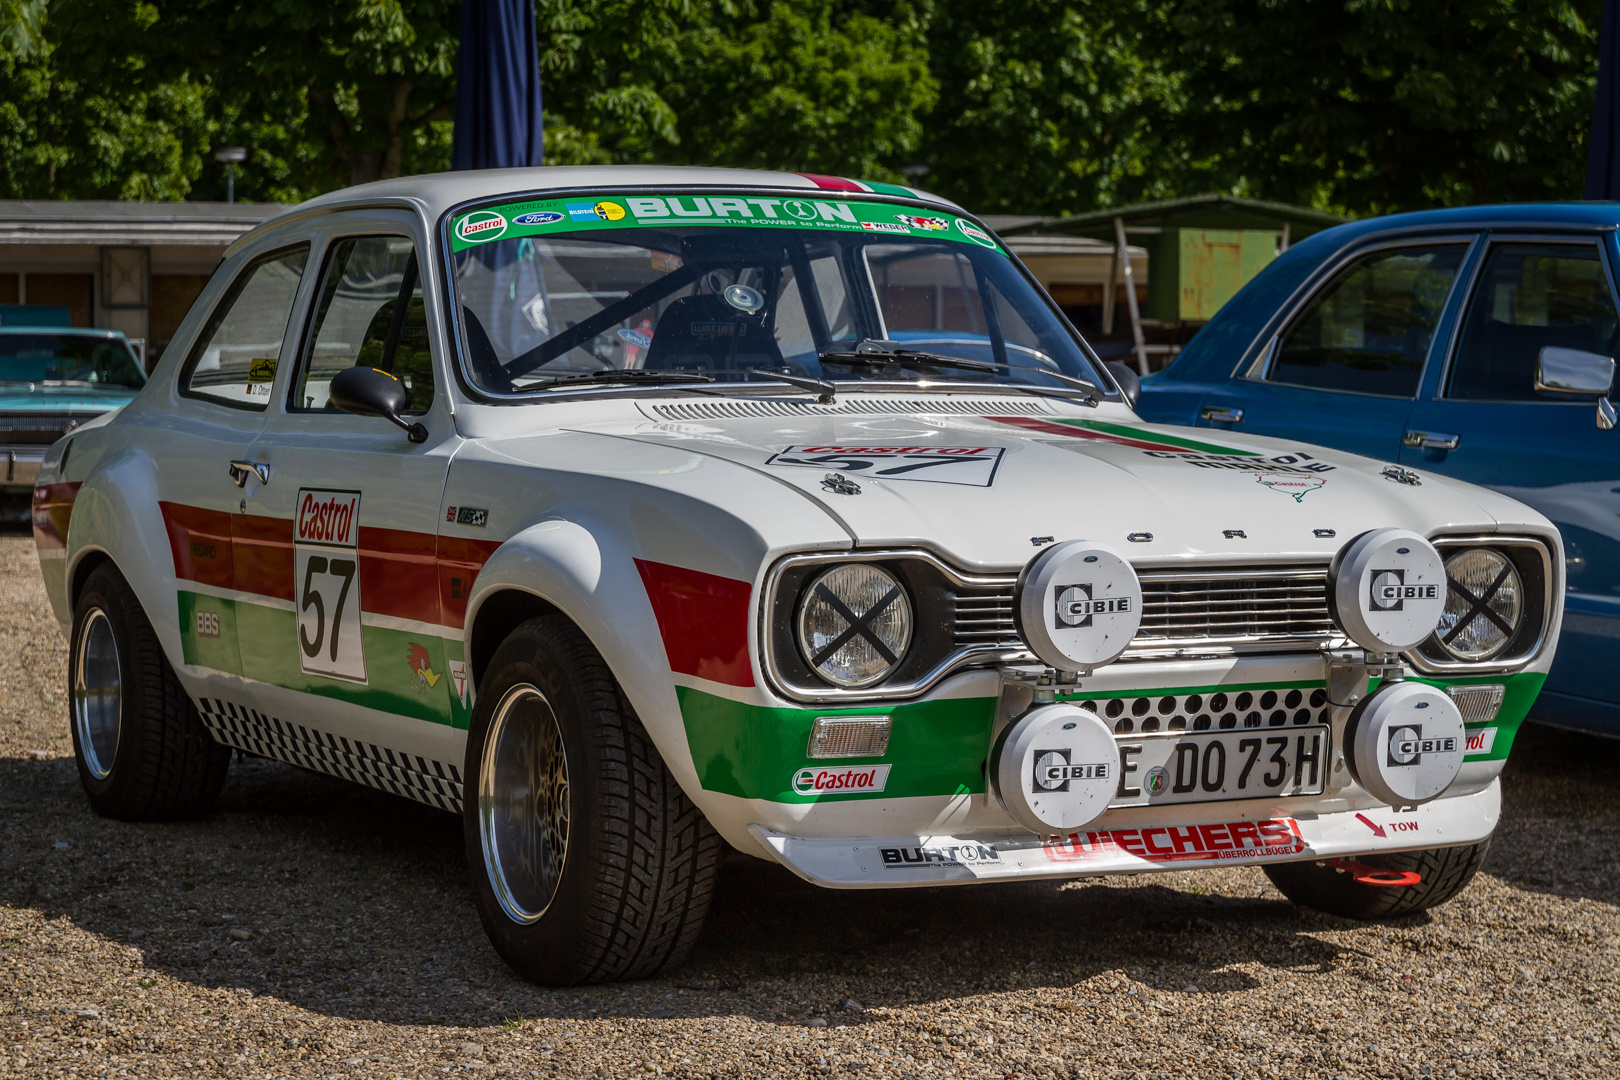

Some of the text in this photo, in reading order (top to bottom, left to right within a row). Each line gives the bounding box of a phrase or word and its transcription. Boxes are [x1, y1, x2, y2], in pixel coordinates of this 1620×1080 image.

[499, 202, 544, 213] POWERED
[626, 198, 858, 223] BURTON
[464, 219, 502, 234] Castrol
[525, 214, 554, 223] Ford
[874, 222, 909, 231] WEBER
[802, 446, 989, 455] Castrol
[776, 454, 993, 475] 57
[299, 493, 356, 543] Castrol
[300, 556, 356, 662] 57
[197, 611, 220, 637] BBS
[1172, 740, 1226, 794] DO
[1238, 735, 1322, 790] 73H
[815, 769, 877, 790] Castrol
[1389, 821, 1419, 832] TOW
[880, 846, 999, 863] BURTON
[1219, 845, 1296, 859] ÜBERROLLBÜGEL
